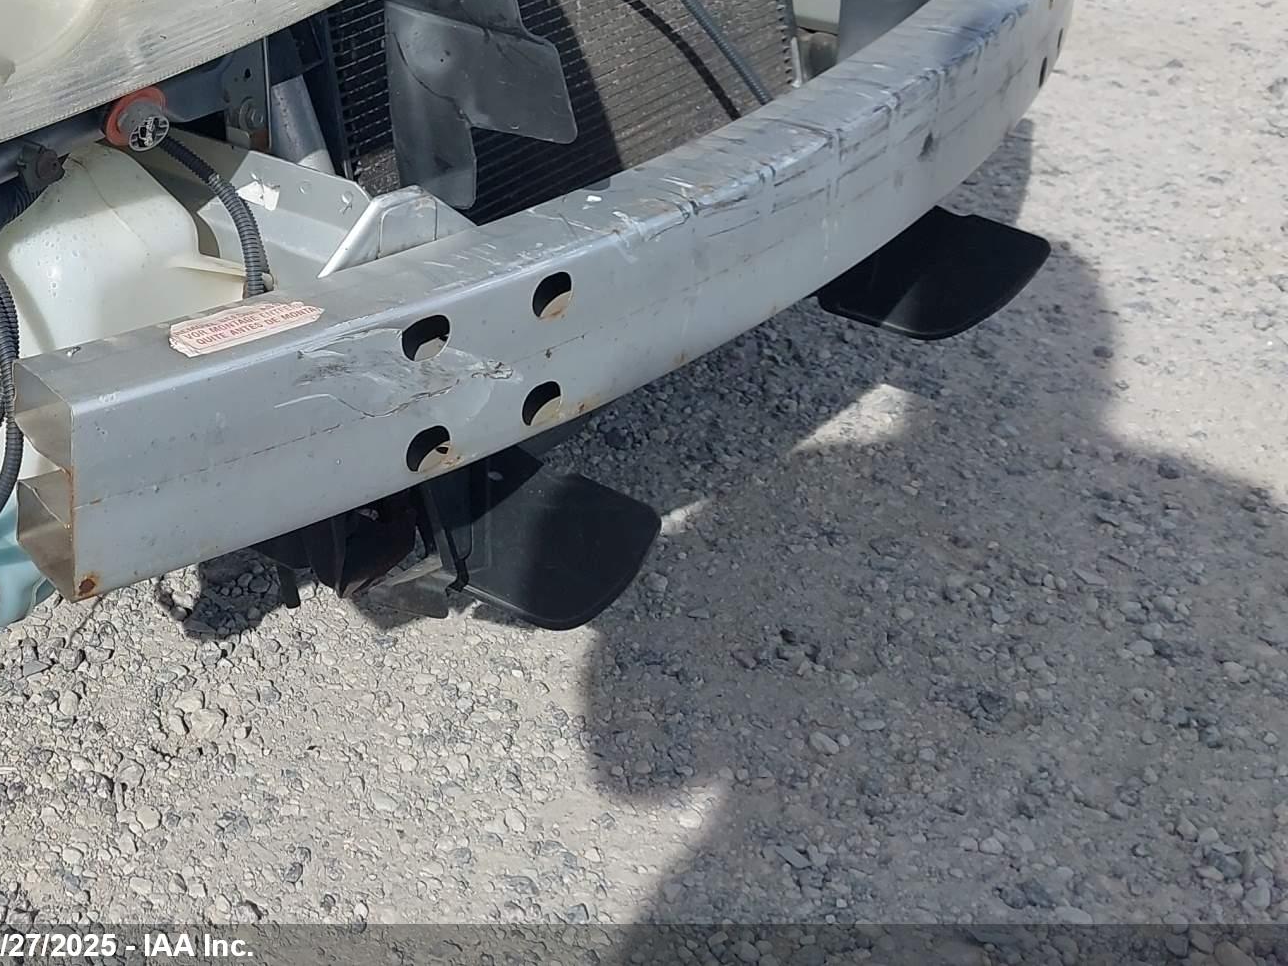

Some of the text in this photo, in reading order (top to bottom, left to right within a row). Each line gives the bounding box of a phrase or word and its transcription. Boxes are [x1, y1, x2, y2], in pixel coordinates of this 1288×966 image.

[183, 329, 208, 340] VOR
[208, 315, 259, 334] MONTAGE
[196, 331, 228, 345] QUITE
[228, 321, 264, 336] ANTES
[263, 316, 281, 326] DE
